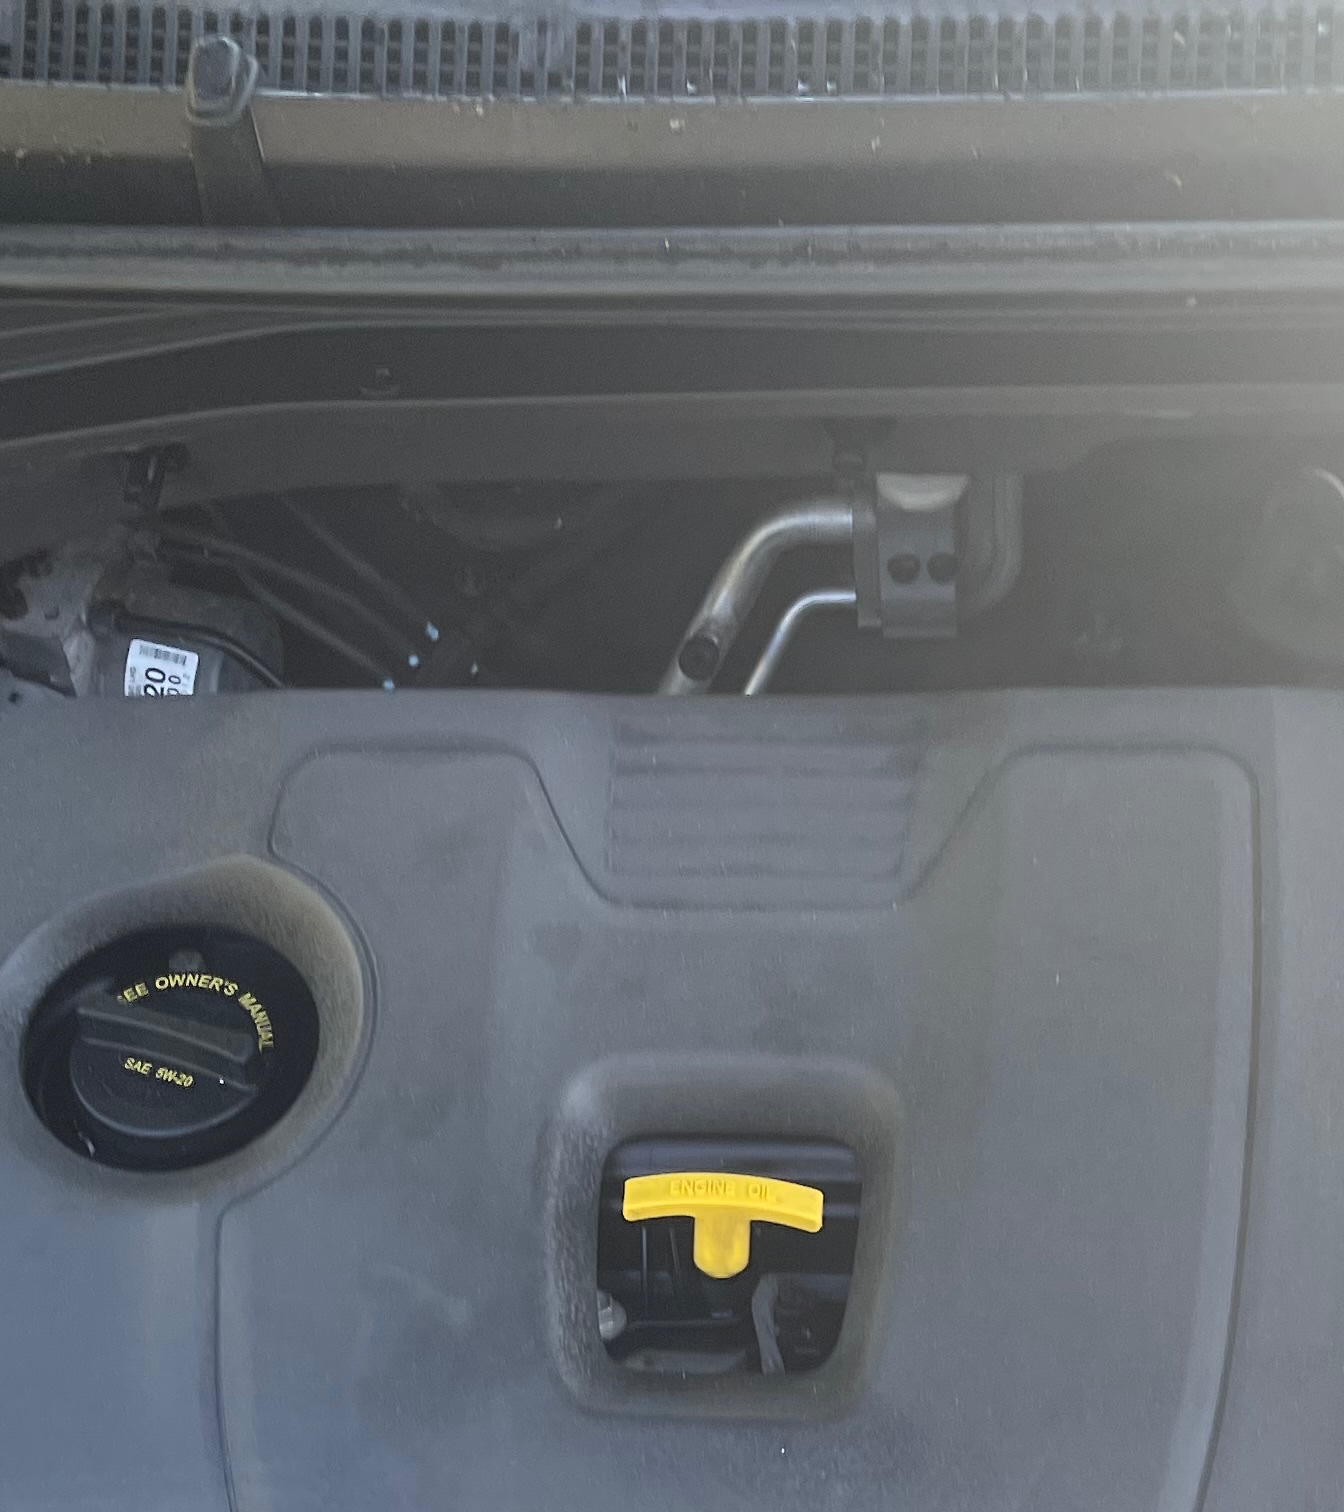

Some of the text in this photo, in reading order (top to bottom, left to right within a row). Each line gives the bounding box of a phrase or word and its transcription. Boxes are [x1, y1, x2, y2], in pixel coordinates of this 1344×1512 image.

[155, 972, 239, 997] OWNER'S
[237, 991, 275, 1054] MANUAL
[124, 1056, 195, 1088] SAE 5W-20
[669, 1178, 777, 1204] ENGINE OIL
